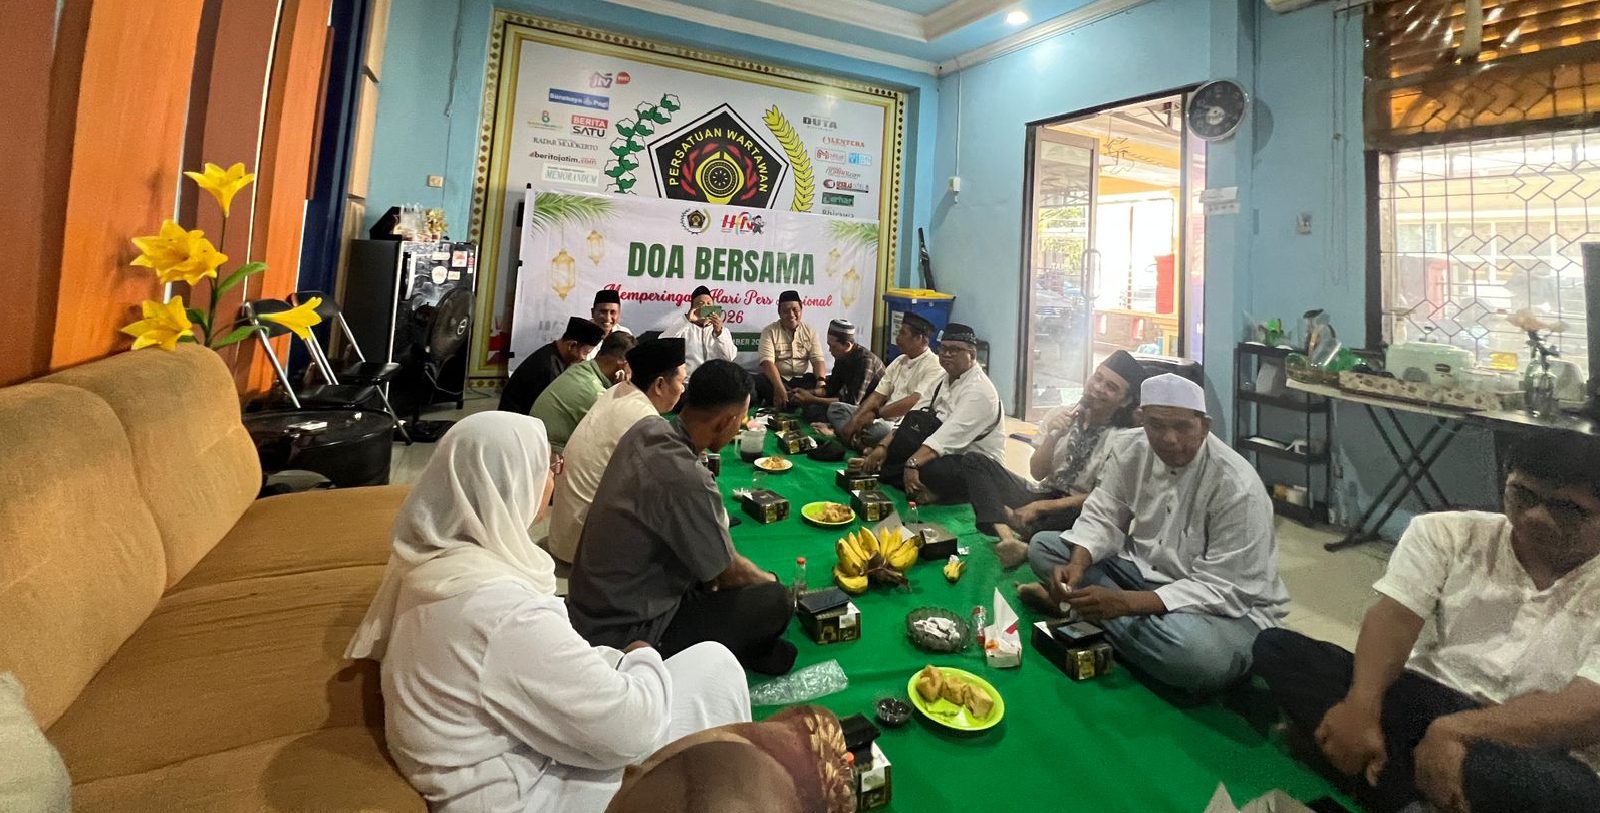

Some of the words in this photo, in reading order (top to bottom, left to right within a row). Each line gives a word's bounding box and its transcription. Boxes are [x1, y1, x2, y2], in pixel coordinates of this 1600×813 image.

[572, 116, 608, 128] BERITA
[803, 116, 838, 129] DUTA
[572, 127, 606, 138] SATU
[533, 137, 556, 146] RADAR
[669, 128, 722, 186] PERSATUAN
[727, 129, 769, 193] WARTAWAN
[544, 169, 598, 184] MEMORANDUM
[627, 241, 685, 279] DOA
[694, 246, 816, 285] BERSAMA
[708, 288, 742, 305] Hari
[743, 289, 774, 306] Pers
